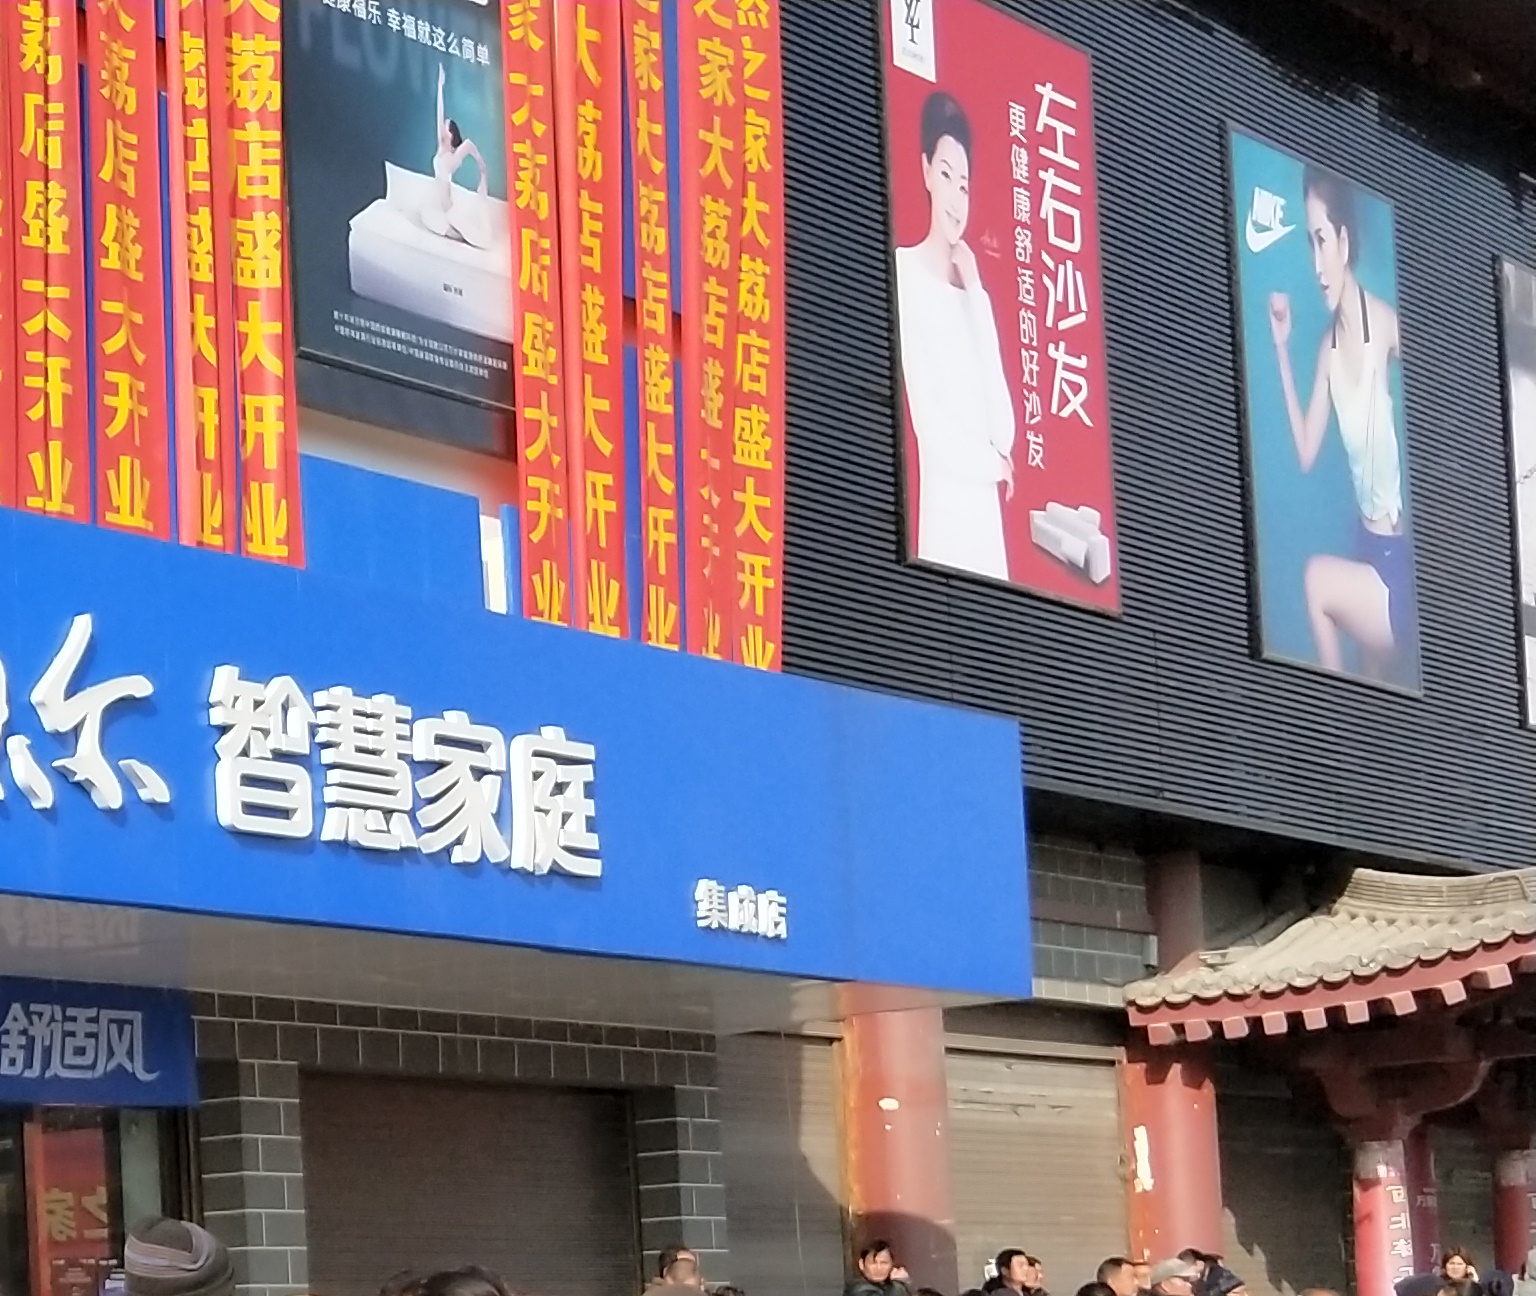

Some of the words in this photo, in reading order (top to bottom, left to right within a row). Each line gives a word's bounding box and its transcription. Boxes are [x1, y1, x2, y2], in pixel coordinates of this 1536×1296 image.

[386, 7, 491, 66] 幸福就这么简单
[180, 0, 225, 546] 荔店盛大开业
[632, 0, 680, 652] 家大荔店盛大开业
[1008, 100, 1046, 471] 更健康舒适的好沙发
[1034, 81, 1095, 428] 左右沙发
[1252, 186, 1287, 229] NIKE
[208, 662, 603, 879] 智慧家庭
[694, 878, 788, 940] 集成店
